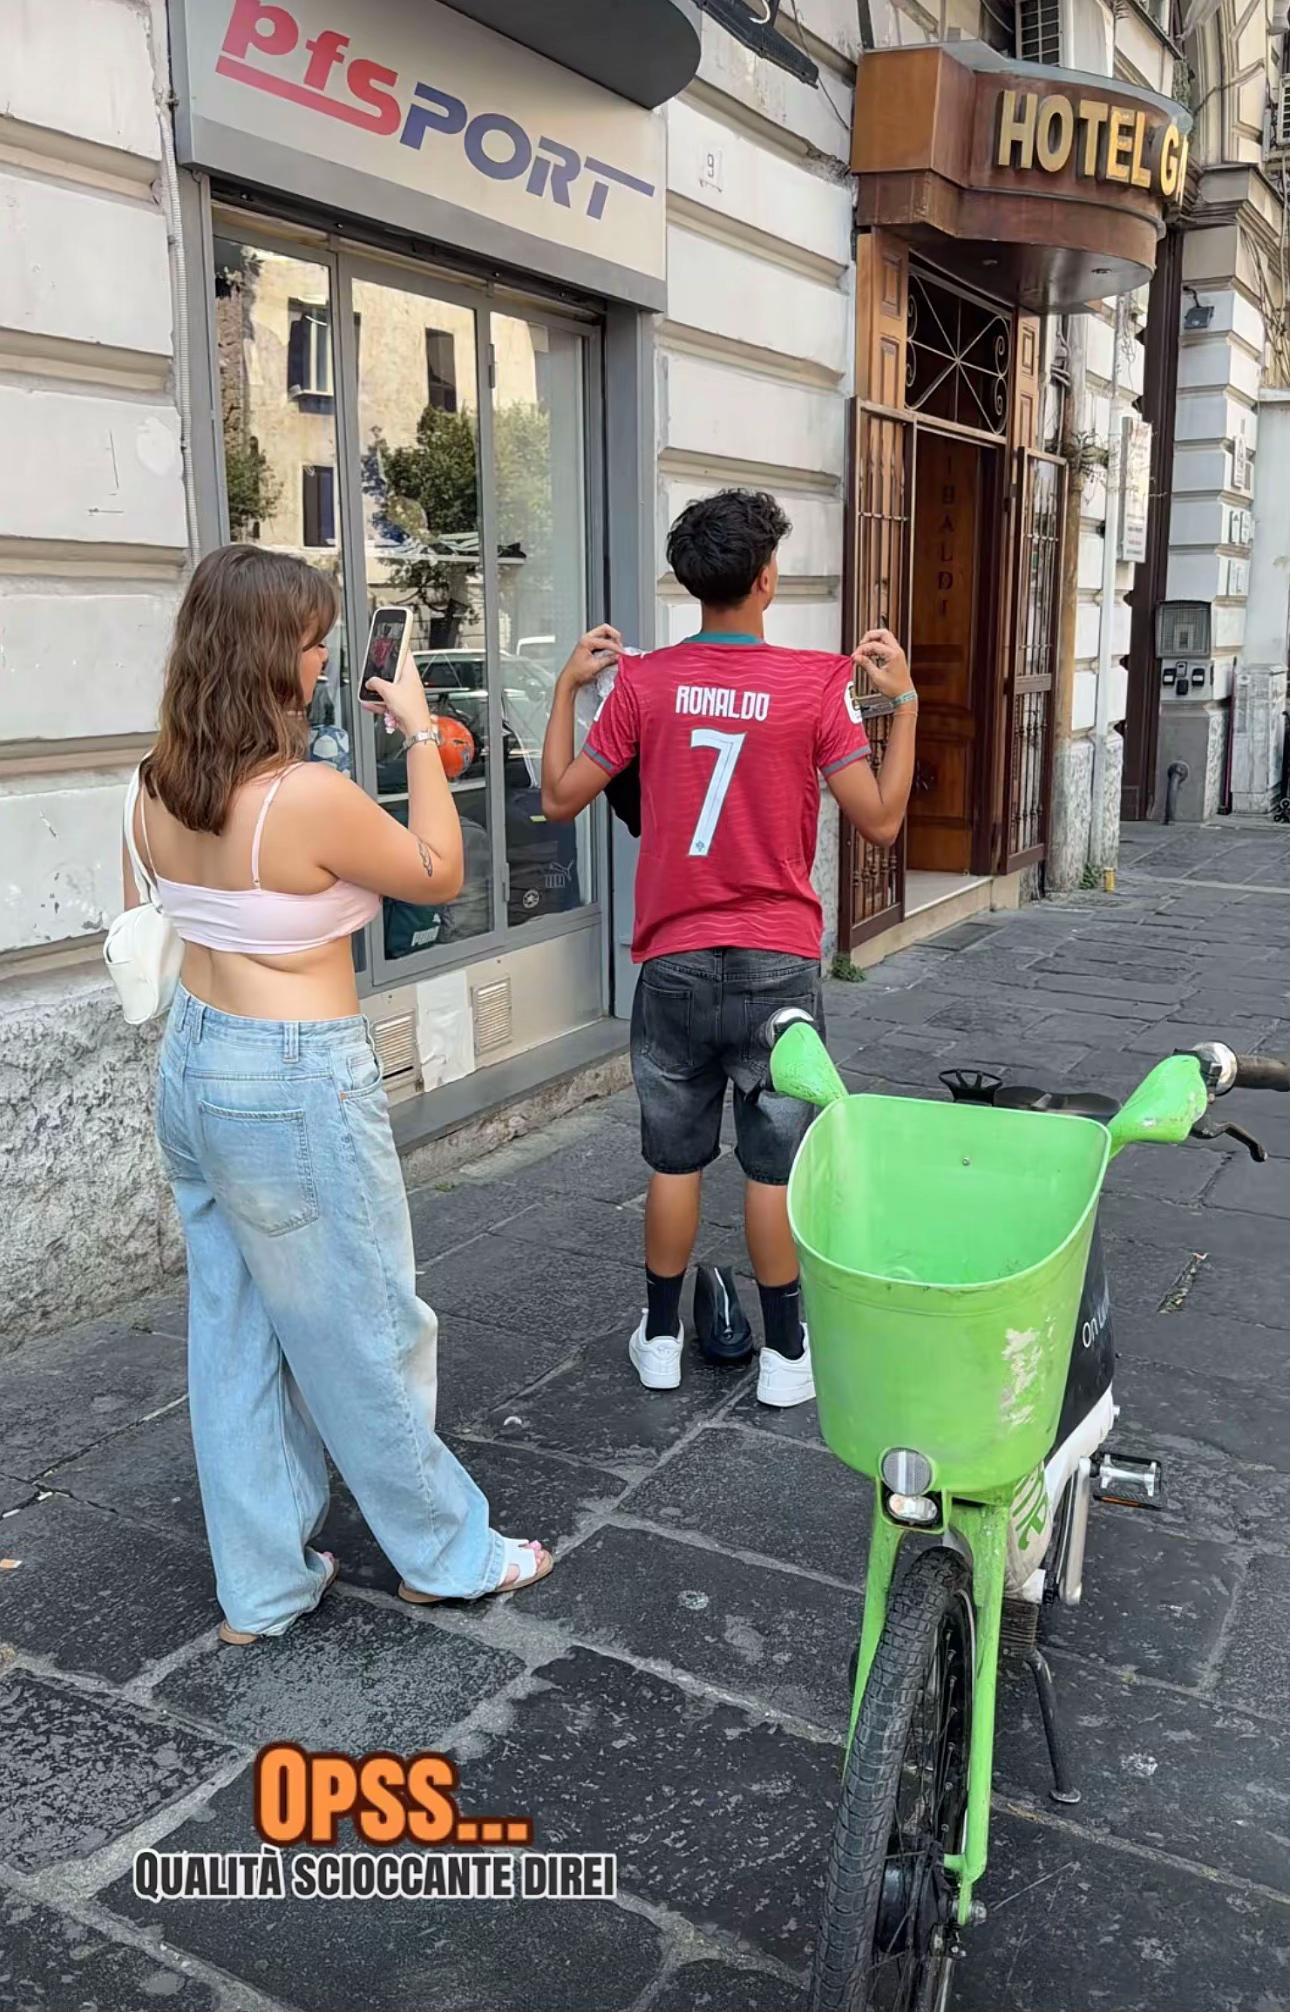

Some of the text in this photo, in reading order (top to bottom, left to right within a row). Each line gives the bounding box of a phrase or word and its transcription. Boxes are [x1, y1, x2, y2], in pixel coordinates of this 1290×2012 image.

[997, 89, 1152, 189] HOTEL
[674, 684, 771, 722] RONALDO
[687, 727, 748, 858] 7
